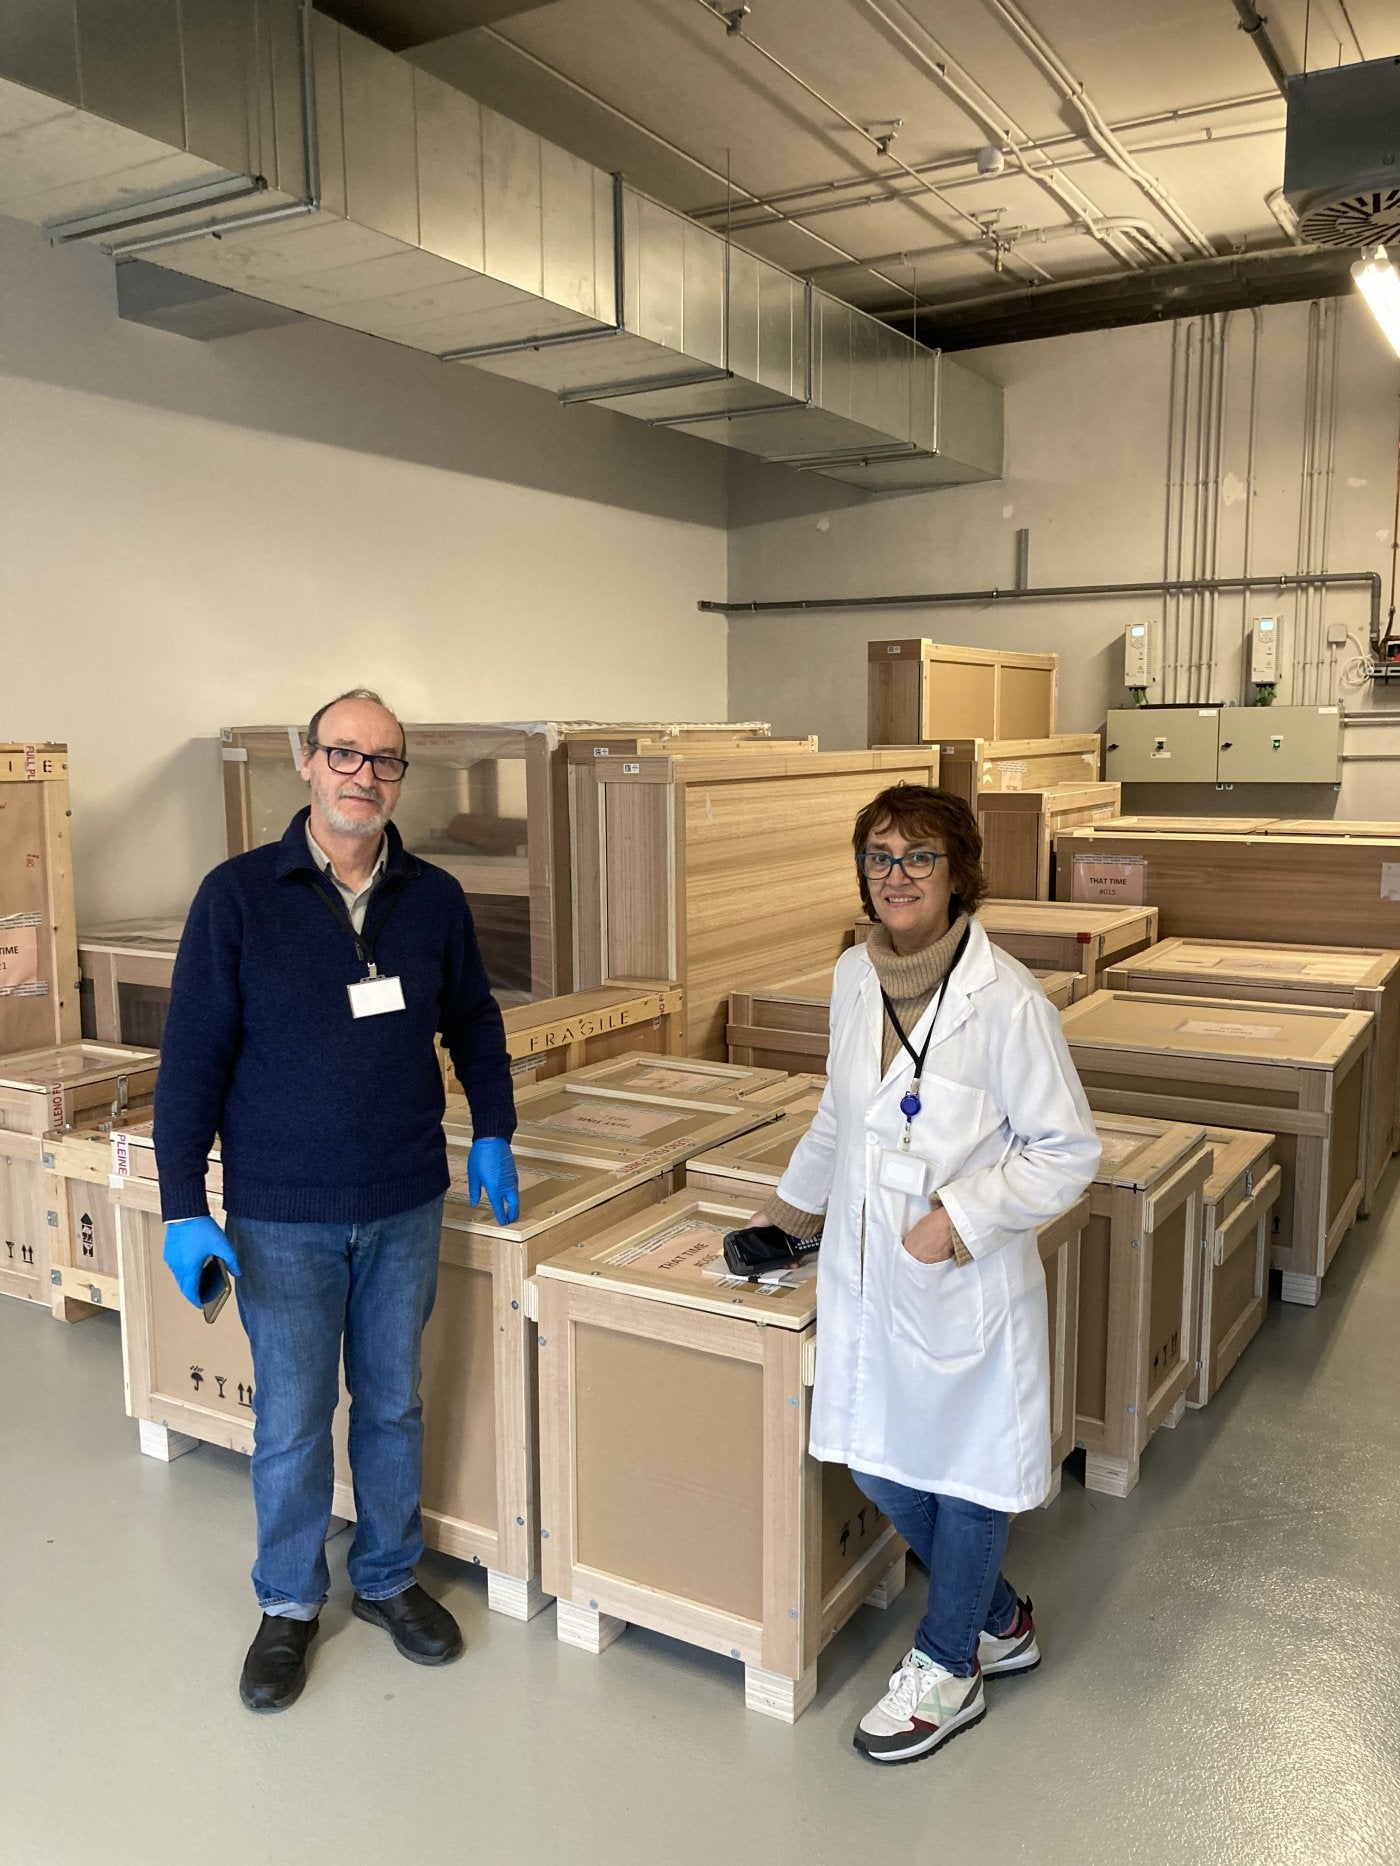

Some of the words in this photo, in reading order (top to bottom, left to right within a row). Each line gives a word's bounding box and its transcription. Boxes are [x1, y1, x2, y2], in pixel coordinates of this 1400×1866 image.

[1089, 877, 1107, 885] THAT
[530, 1010, 629, 1051] FRAGILE
[53, 1097, 63, 1127] LLENO
[116, 1133, 128, 1176] PLEINE
[658, 1255, 687, 1270] THAT
[681, 1243, 710, 1256] TIME
